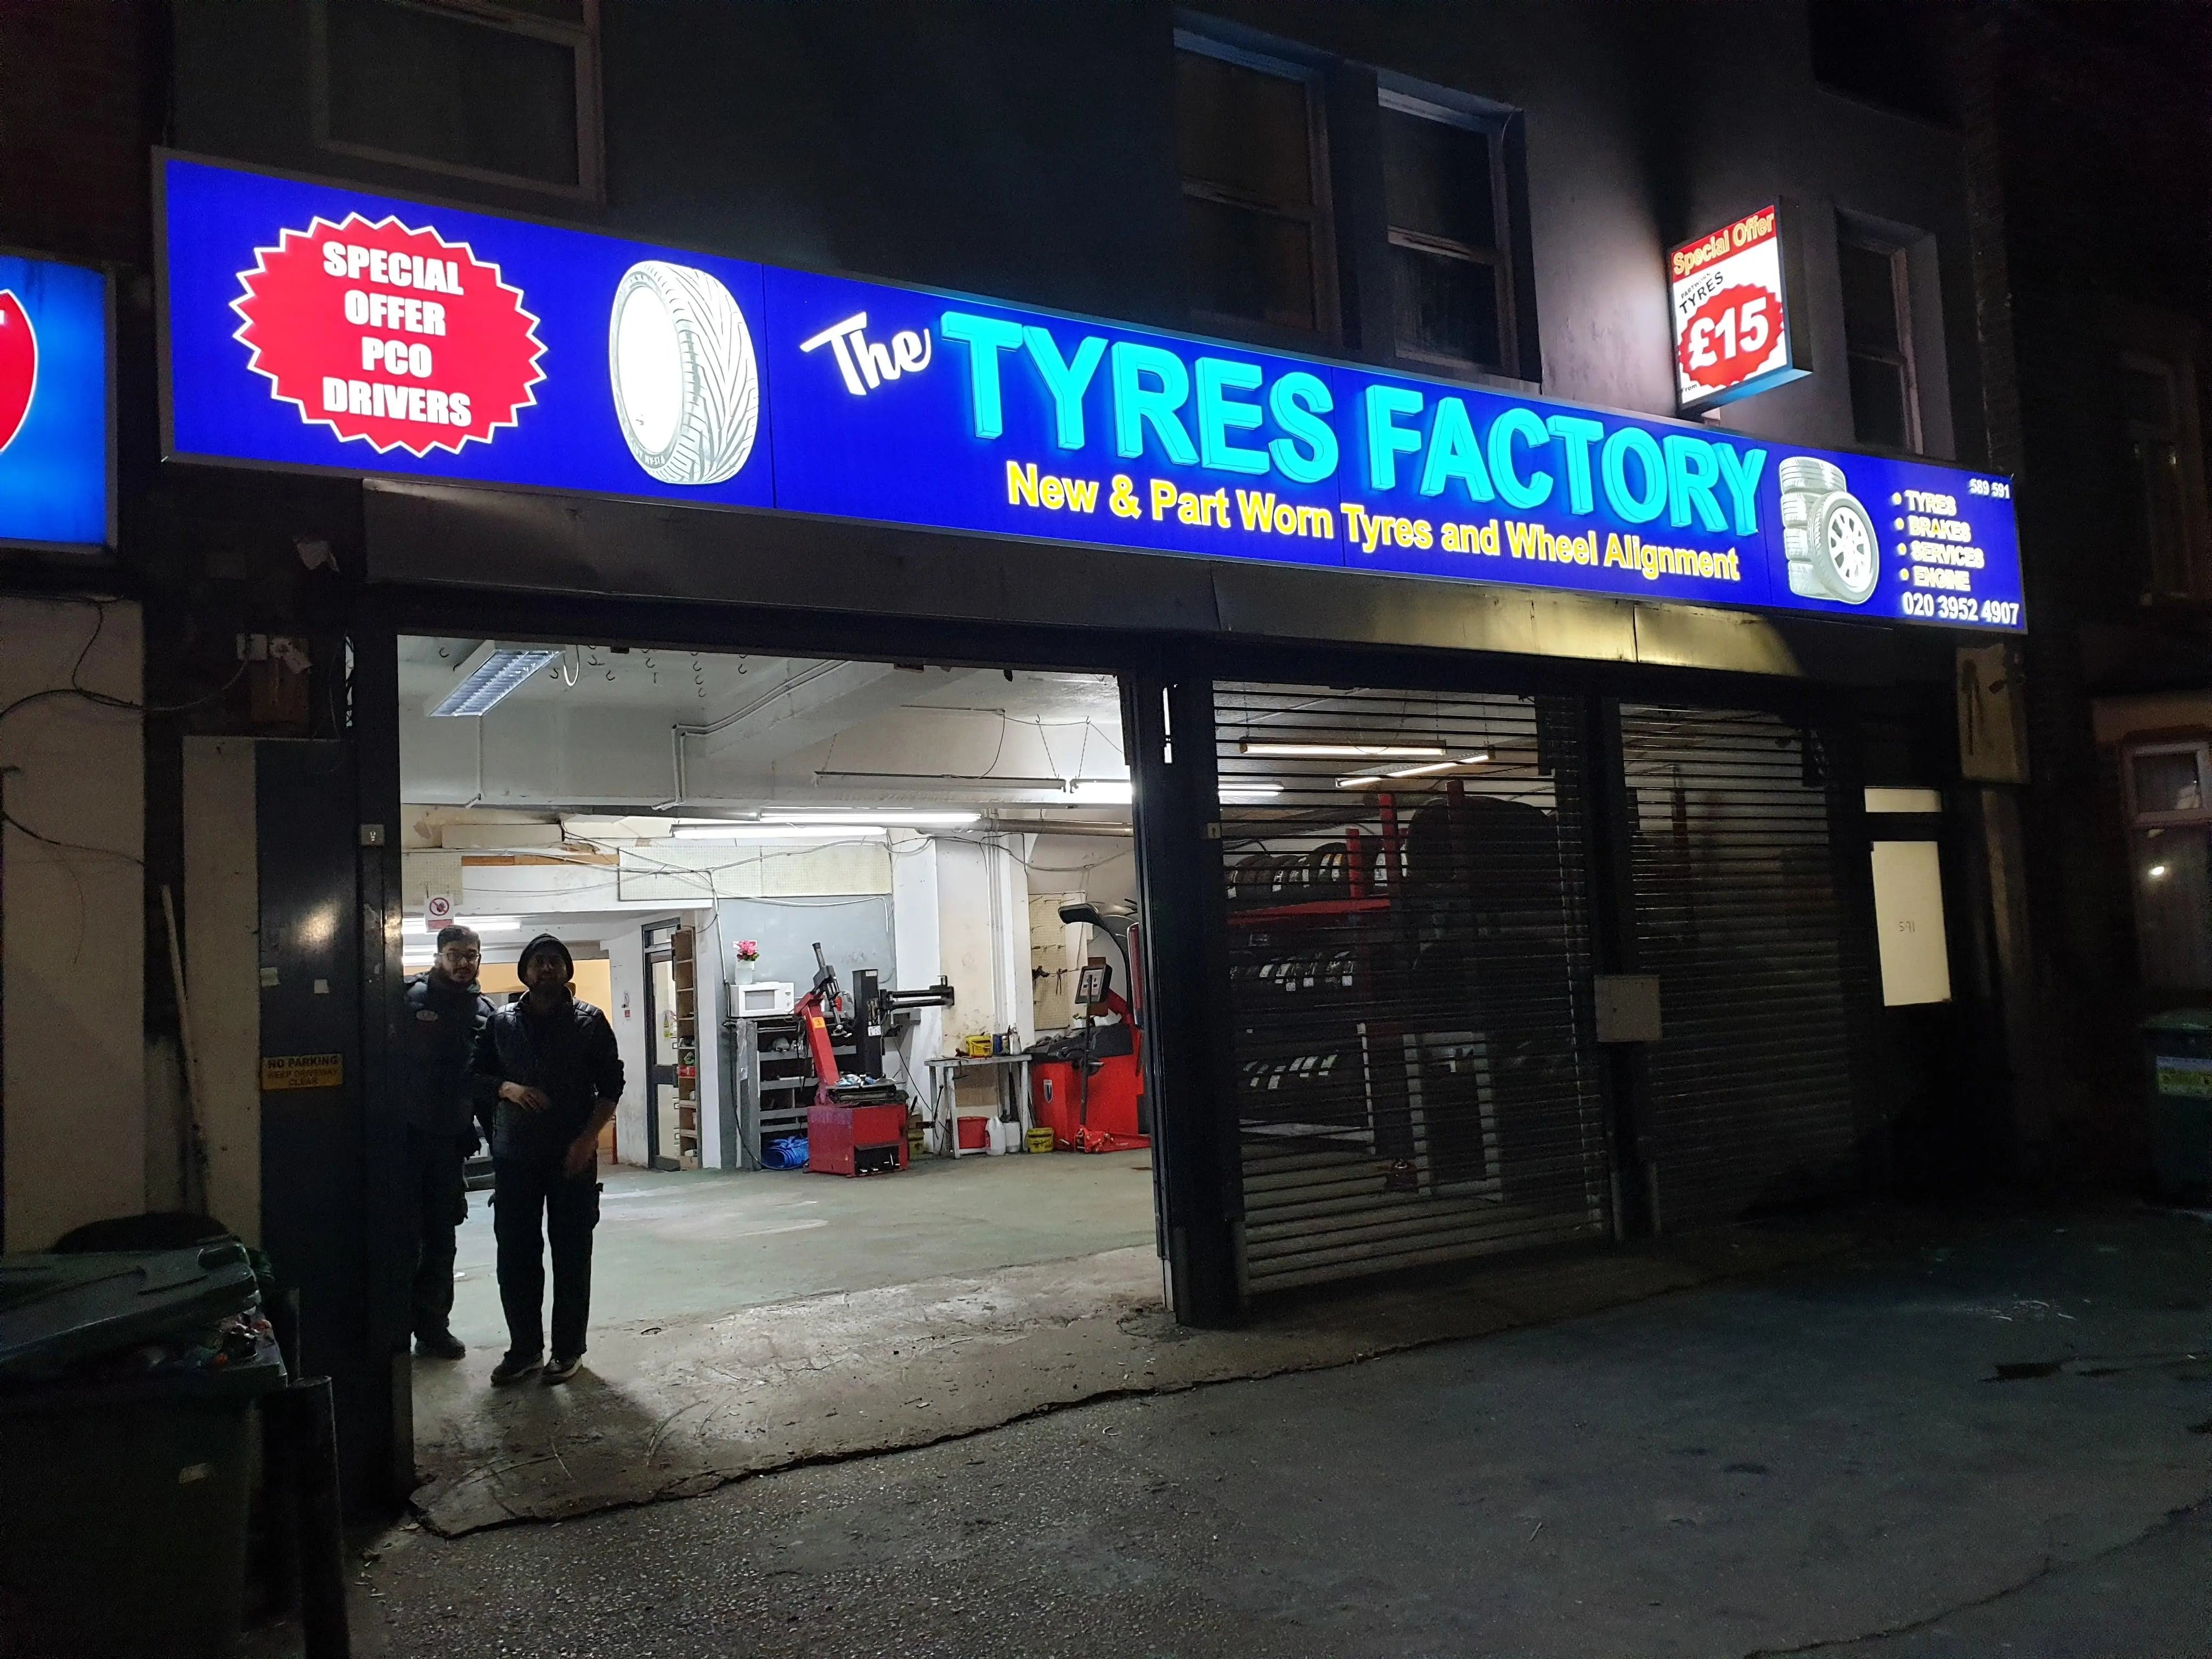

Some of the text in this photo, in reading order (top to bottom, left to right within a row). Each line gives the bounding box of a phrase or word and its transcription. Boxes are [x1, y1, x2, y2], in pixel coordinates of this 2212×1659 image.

[1673, 212, 1775, 276] Special Offer
[321, 240, 464, 296] SPECIAL
[344, 290, 447, 337] OFFER
[1679, 271, 1724, 314] TYRES
[1688, 296, 1769, 371] £15
[361, 336, 433, 379] PCO
[321, 376, 472, 428] DRIVERS
[799, 311, 1768, 537] The TYRES FACTORY
[1904, 489, 1957, 516] TYRES
[1968, 478, 2010, 499] 589 591
[1006, 460, 1740, 581] New & Part Worn Tyres and Wheel Alignment
[1908, 515, 1972, 543] BRAKES
[1910, 540, 1985, 569] SERVICES
[1912, 566, 1971, 591] ENGINE
[1902, 591, 2019, 625] 020 3952 4907
[268, 1056, 338, 1069] NO PARKING
